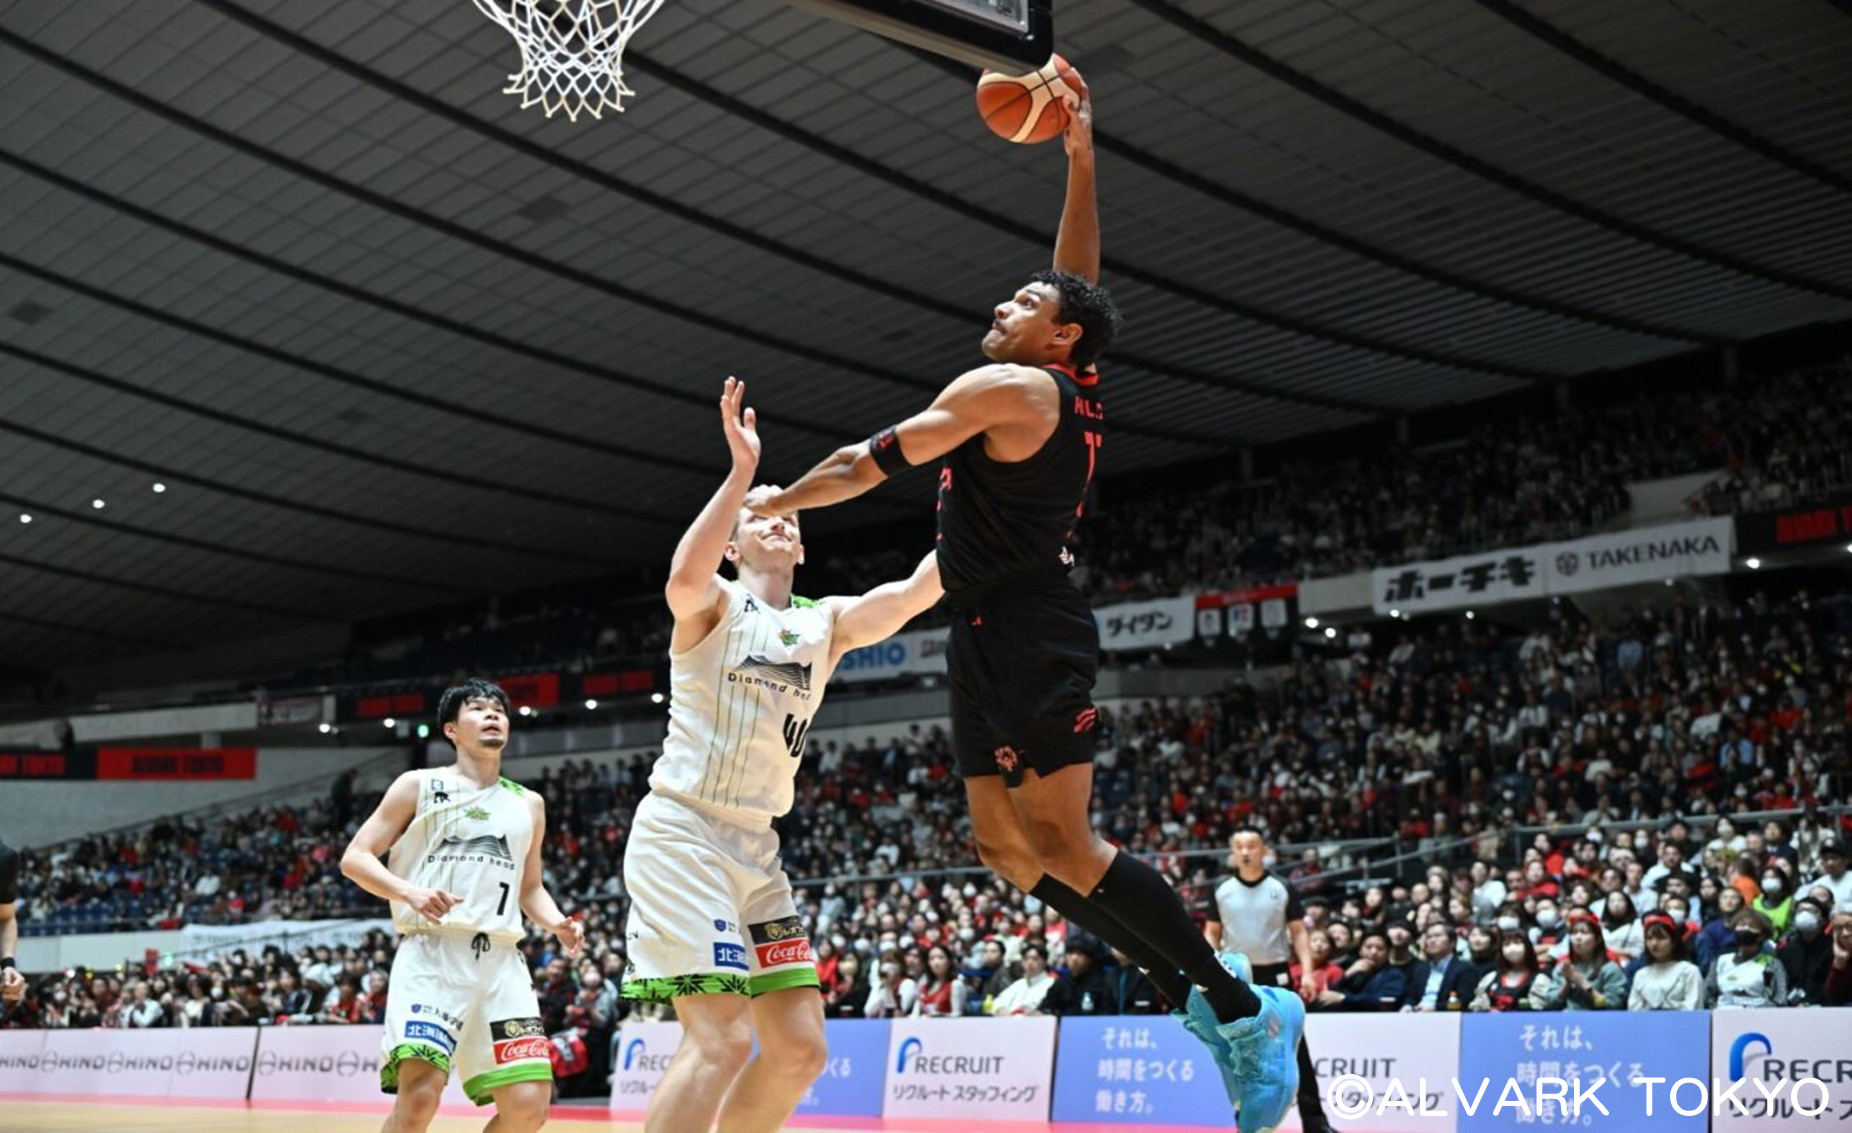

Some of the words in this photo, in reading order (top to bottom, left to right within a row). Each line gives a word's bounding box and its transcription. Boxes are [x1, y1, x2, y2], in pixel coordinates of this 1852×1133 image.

[1587, 534, 1720, 569] TAKENAKA
[1384, 554, 1535, 602] ホーチキ
[842, 641, 906, 671] SHIO
[427, 854, 484, 864] Diamond
[489, 856, 515, 871] head
[496, 881, 510, 916] 7
[1102, 1026, 1157, 1049] それは、
[1519, 1024, 1593, 1050] それは、
[59, 1055, 105, 1070] HINO
[125, 1055, 173, 1071] HINO
[197, 1056, 249, 1072] HINO
[278, 1056, 334, 1072] HINO
[914, 1056, 1005, 1075] RECRUIT
[1097, 1059, 1194, 1082] 時間をつくる
[1315, 1058, 1397, 1078] CRUIT
[1763, 1060, 1852, 1083] RECR
[893, 1085, 951, 1101] リクルート
[953, 1085, 1038, 1103] スタッフィング
